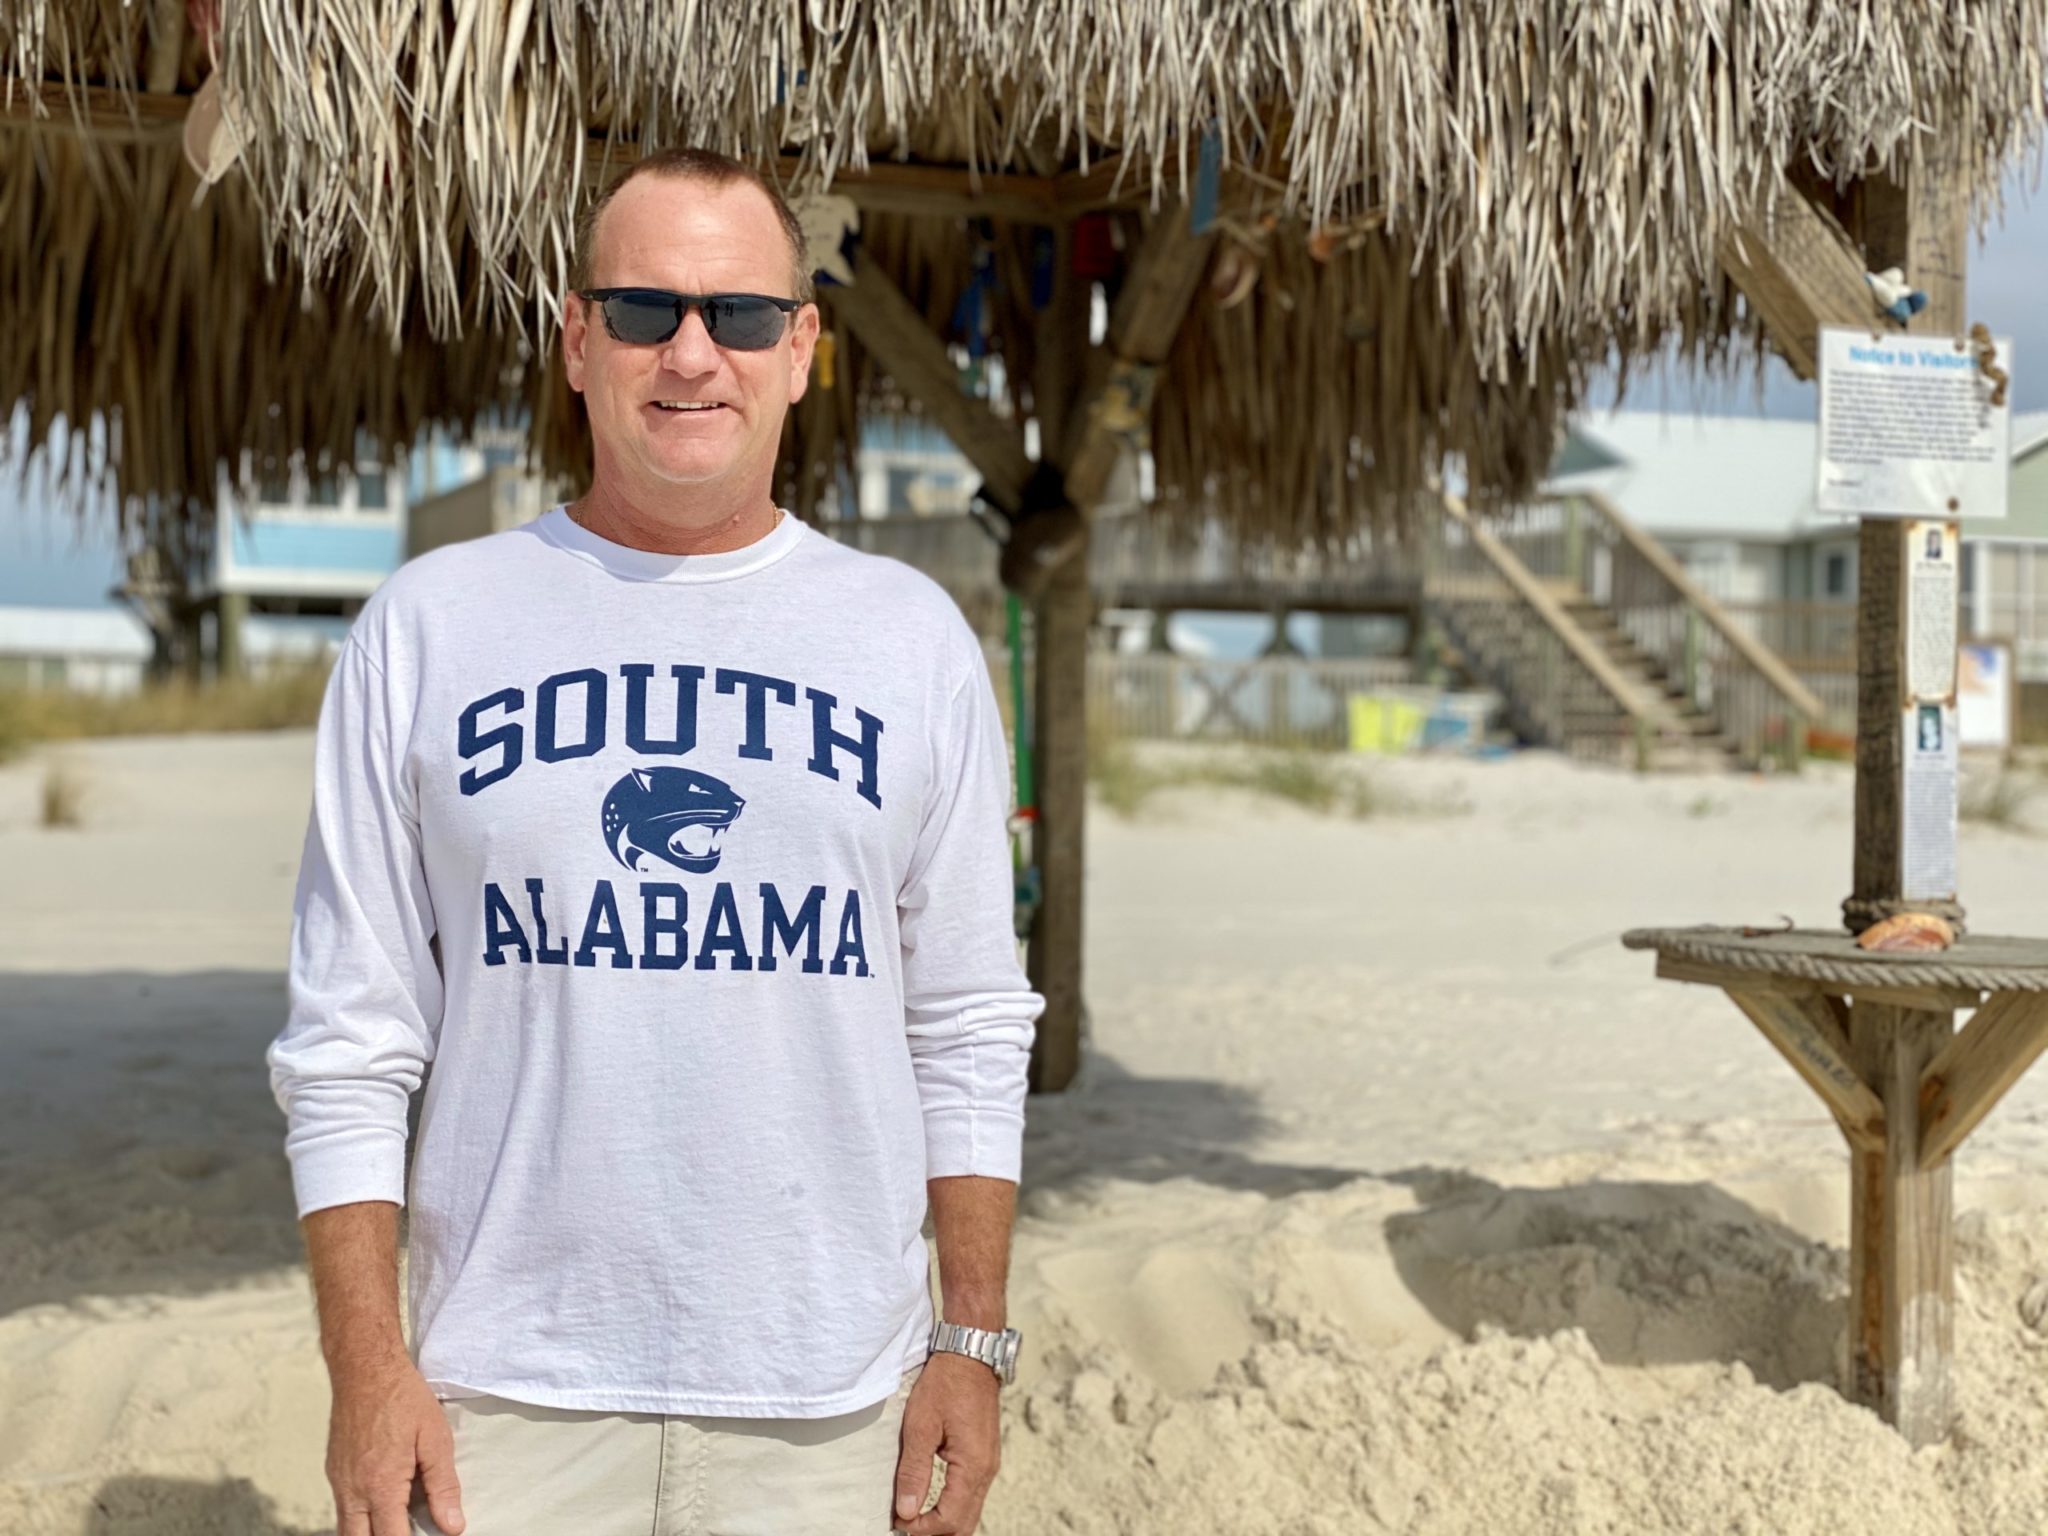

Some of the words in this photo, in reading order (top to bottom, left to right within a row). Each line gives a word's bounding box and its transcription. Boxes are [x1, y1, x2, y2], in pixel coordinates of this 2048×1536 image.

[1849, 346, 1894, 365] Notice
[1899, 351, 1914, 366] to
[458, 664, 884, 811] SOUTH
[482, 878, 869, 977] ALABAMA
